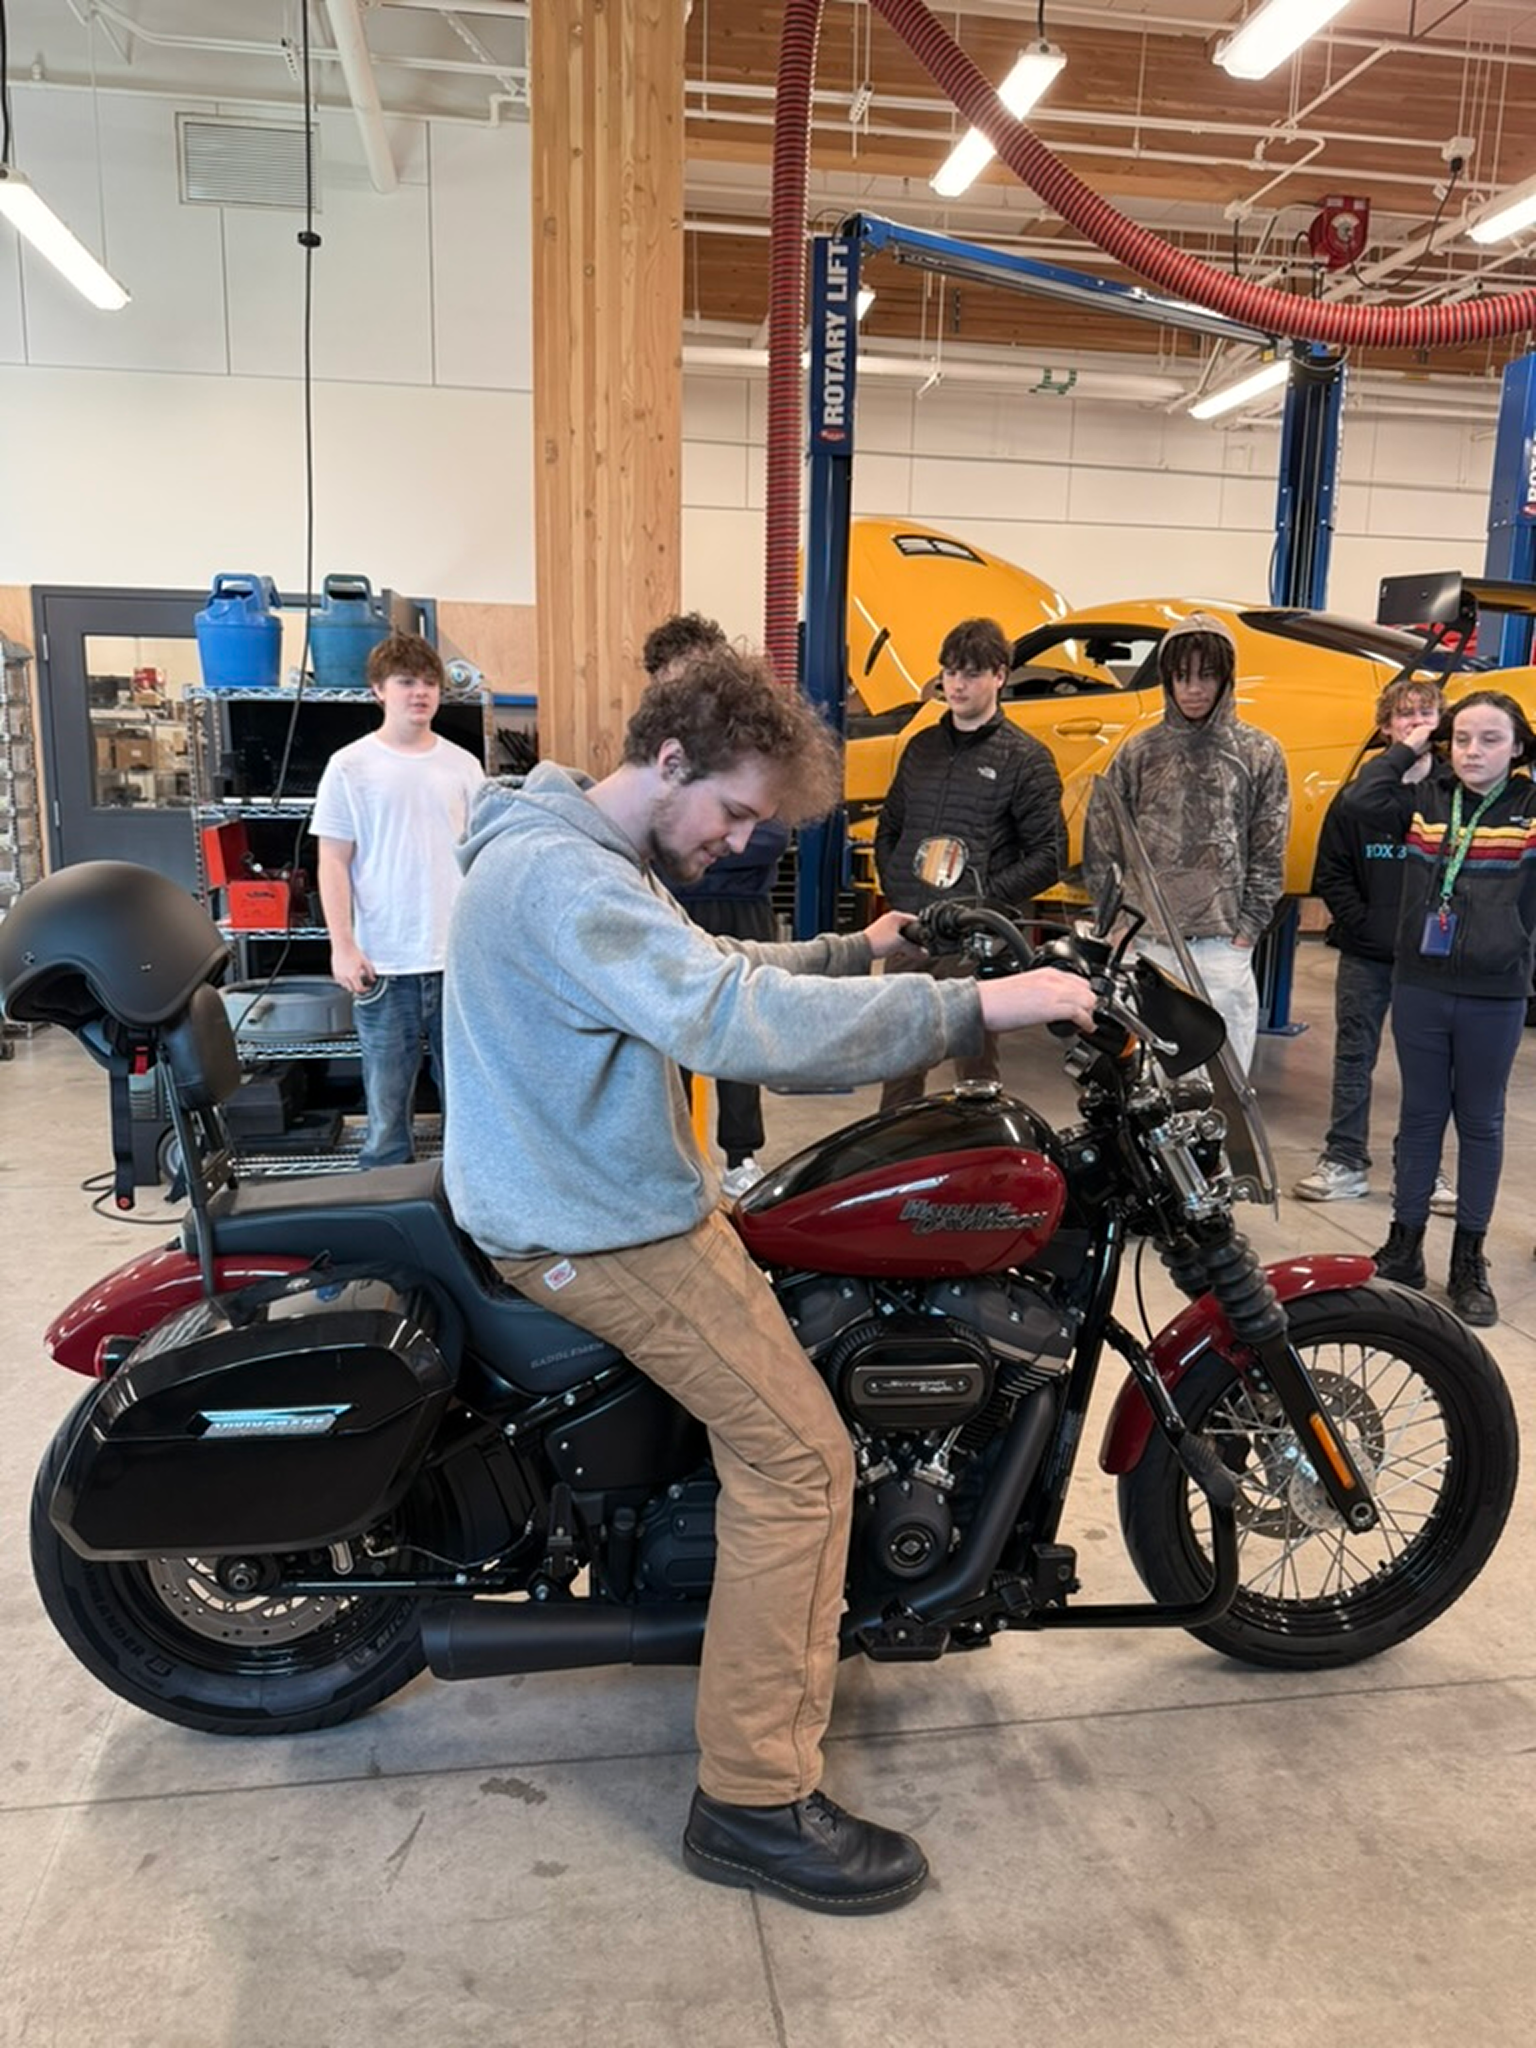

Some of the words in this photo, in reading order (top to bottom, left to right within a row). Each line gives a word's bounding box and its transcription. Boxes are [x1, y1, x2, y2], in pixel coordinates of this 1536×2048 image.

[826, 241, 849, 301] LIFT
[823, 310, 847, 426] ROTARY
[1364, 843, 1393, 859] FOX
[912, 1210, 1049, 1236] DAVIDSON
